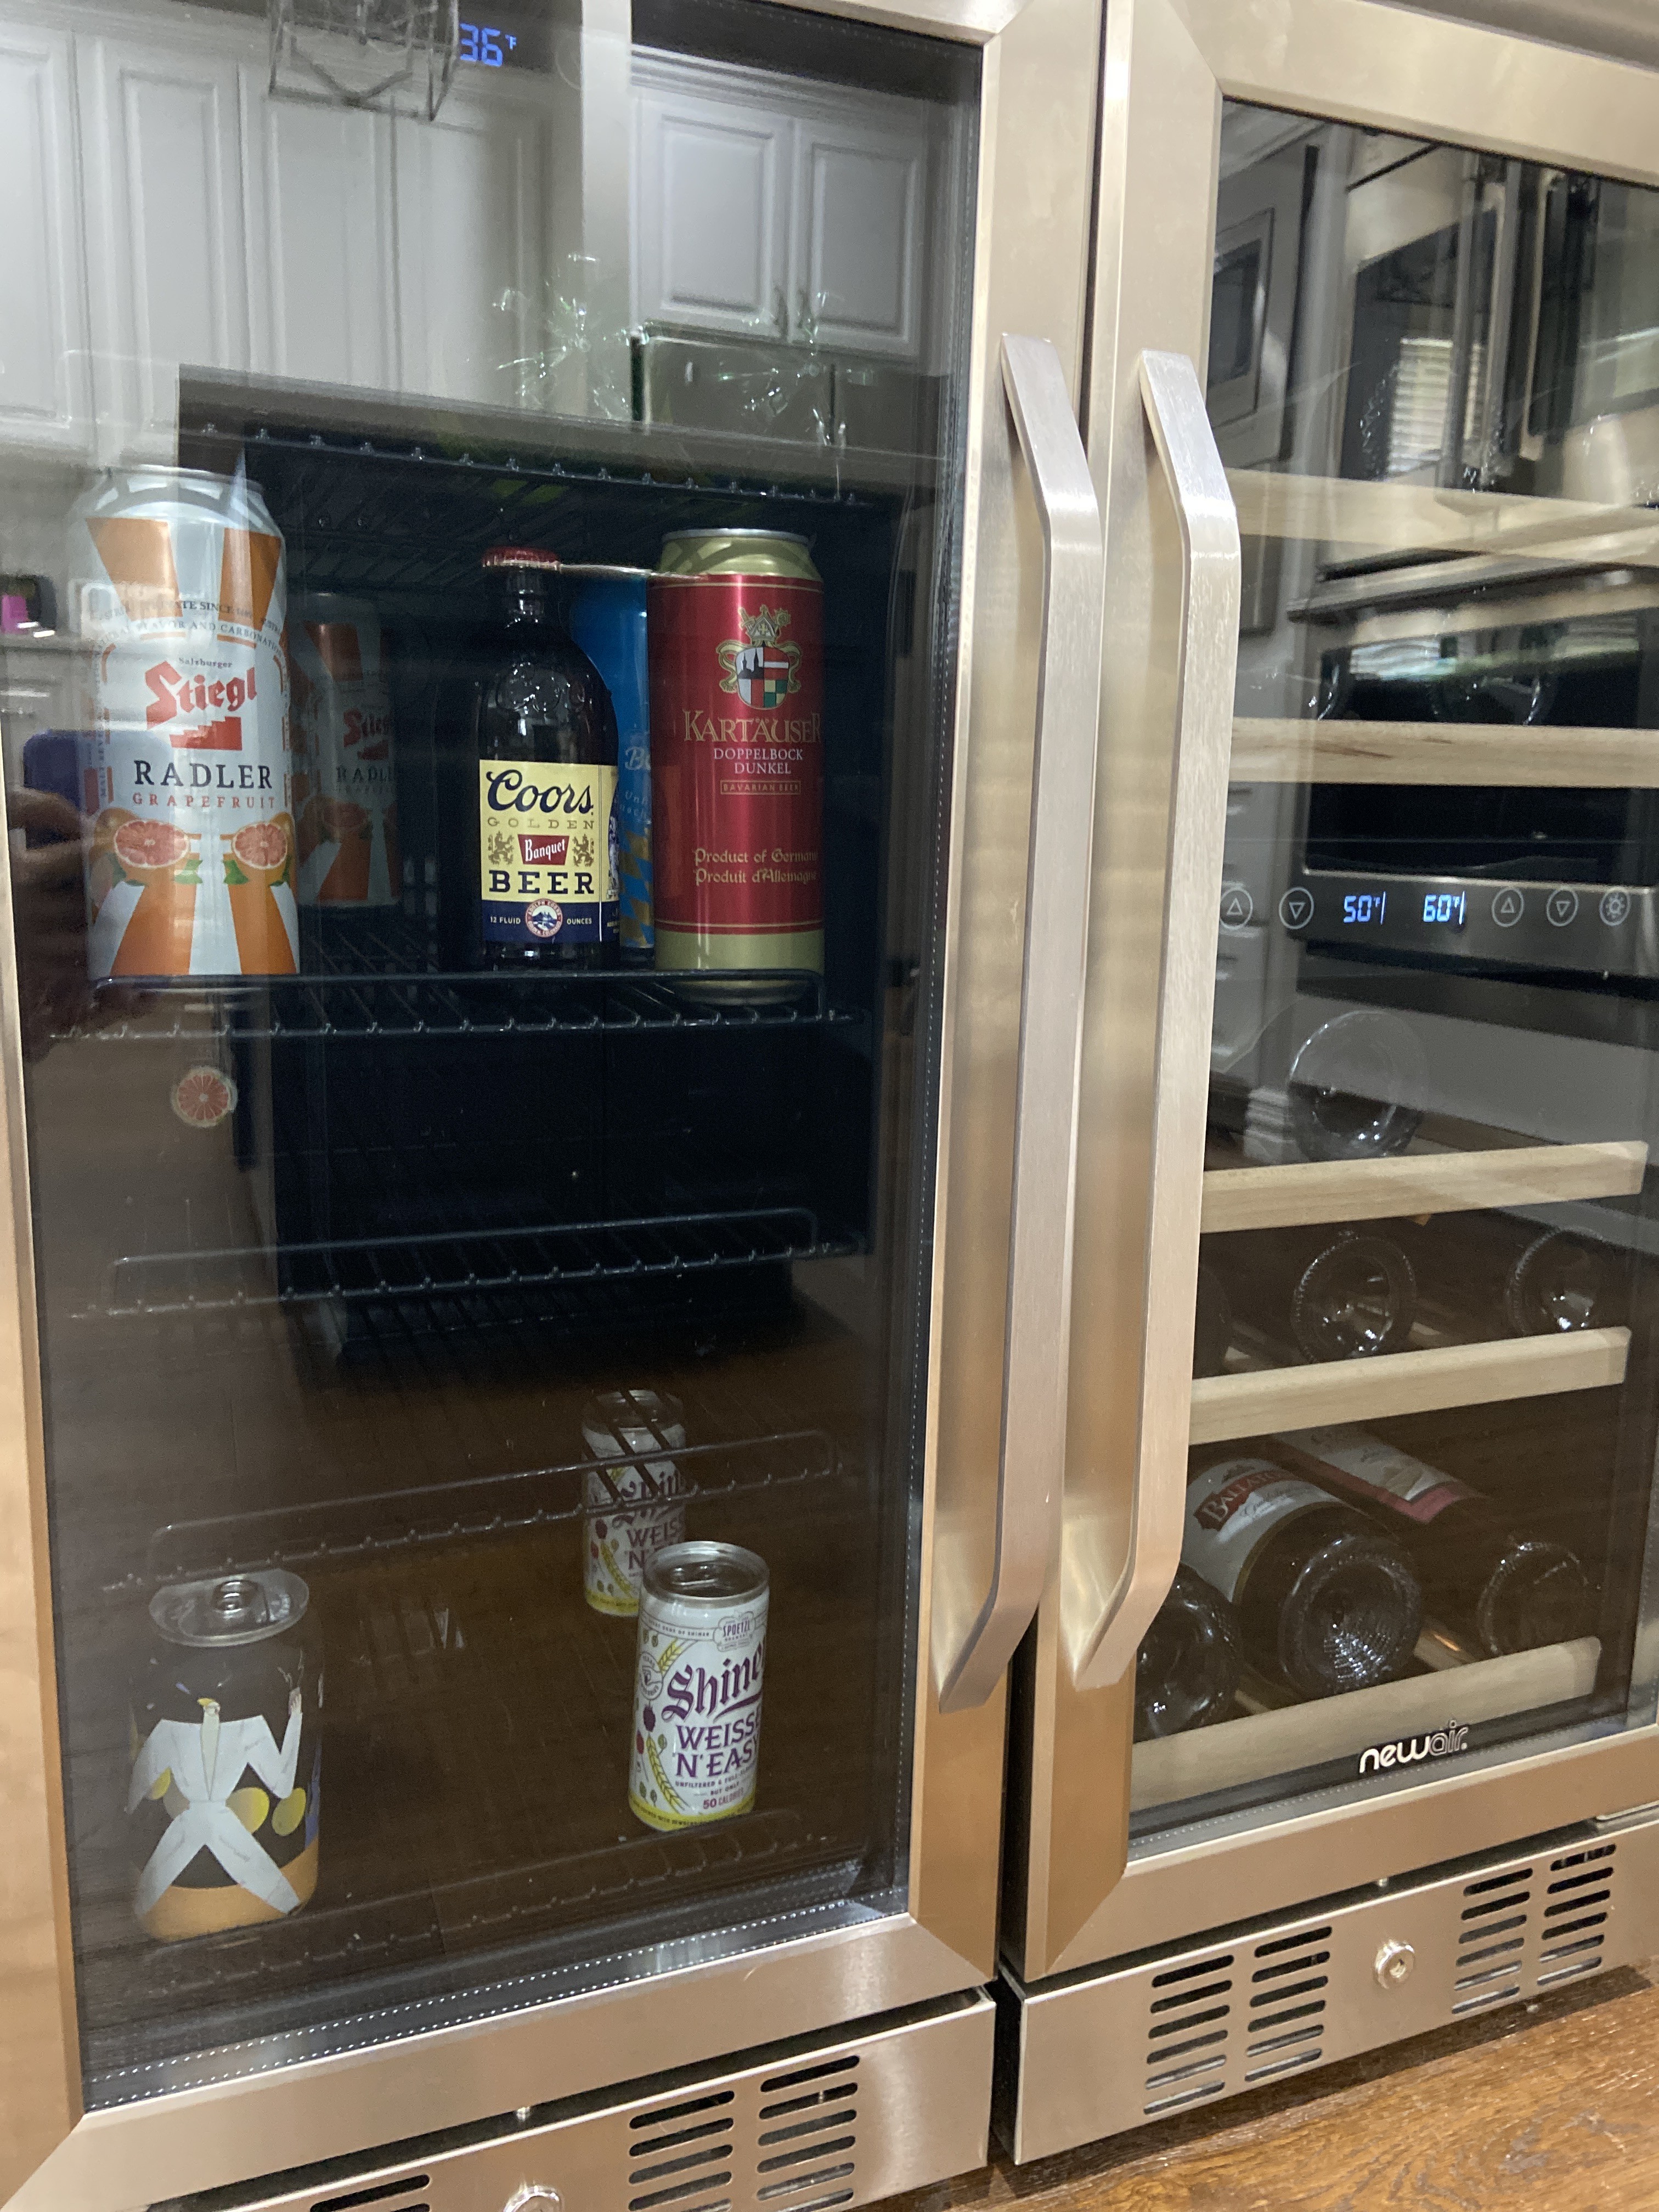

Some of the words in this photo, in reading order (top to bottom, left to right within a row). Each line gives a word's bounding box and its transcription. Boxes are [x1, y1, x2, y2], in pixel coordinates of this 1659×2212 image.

[178, 658, 233, 669] Salzburger
[145, 660, 257, 730] Stiegl
[714, 747, 804, 761] DOPPELBOCK
[133, 759, 273, 788] RADLER
[734, 761, 792, 775] DUNKEL
[723, 783, 775, 792] BAVARIAN
[132, 792, 275, 809] GRAPEFRUIT
[487, 817, 595, 830] GOLDEN
[524, 838, 566, 862] Banquet
[694, 848, 748, 866] Product
[753, 849, 768, 863] of
[489, 870, 595, 895] BEER
[695, 867, 747, 887] Produit
[499, 916, 521, 924] FLUID
[703, 1798, 717, 1810] 50
